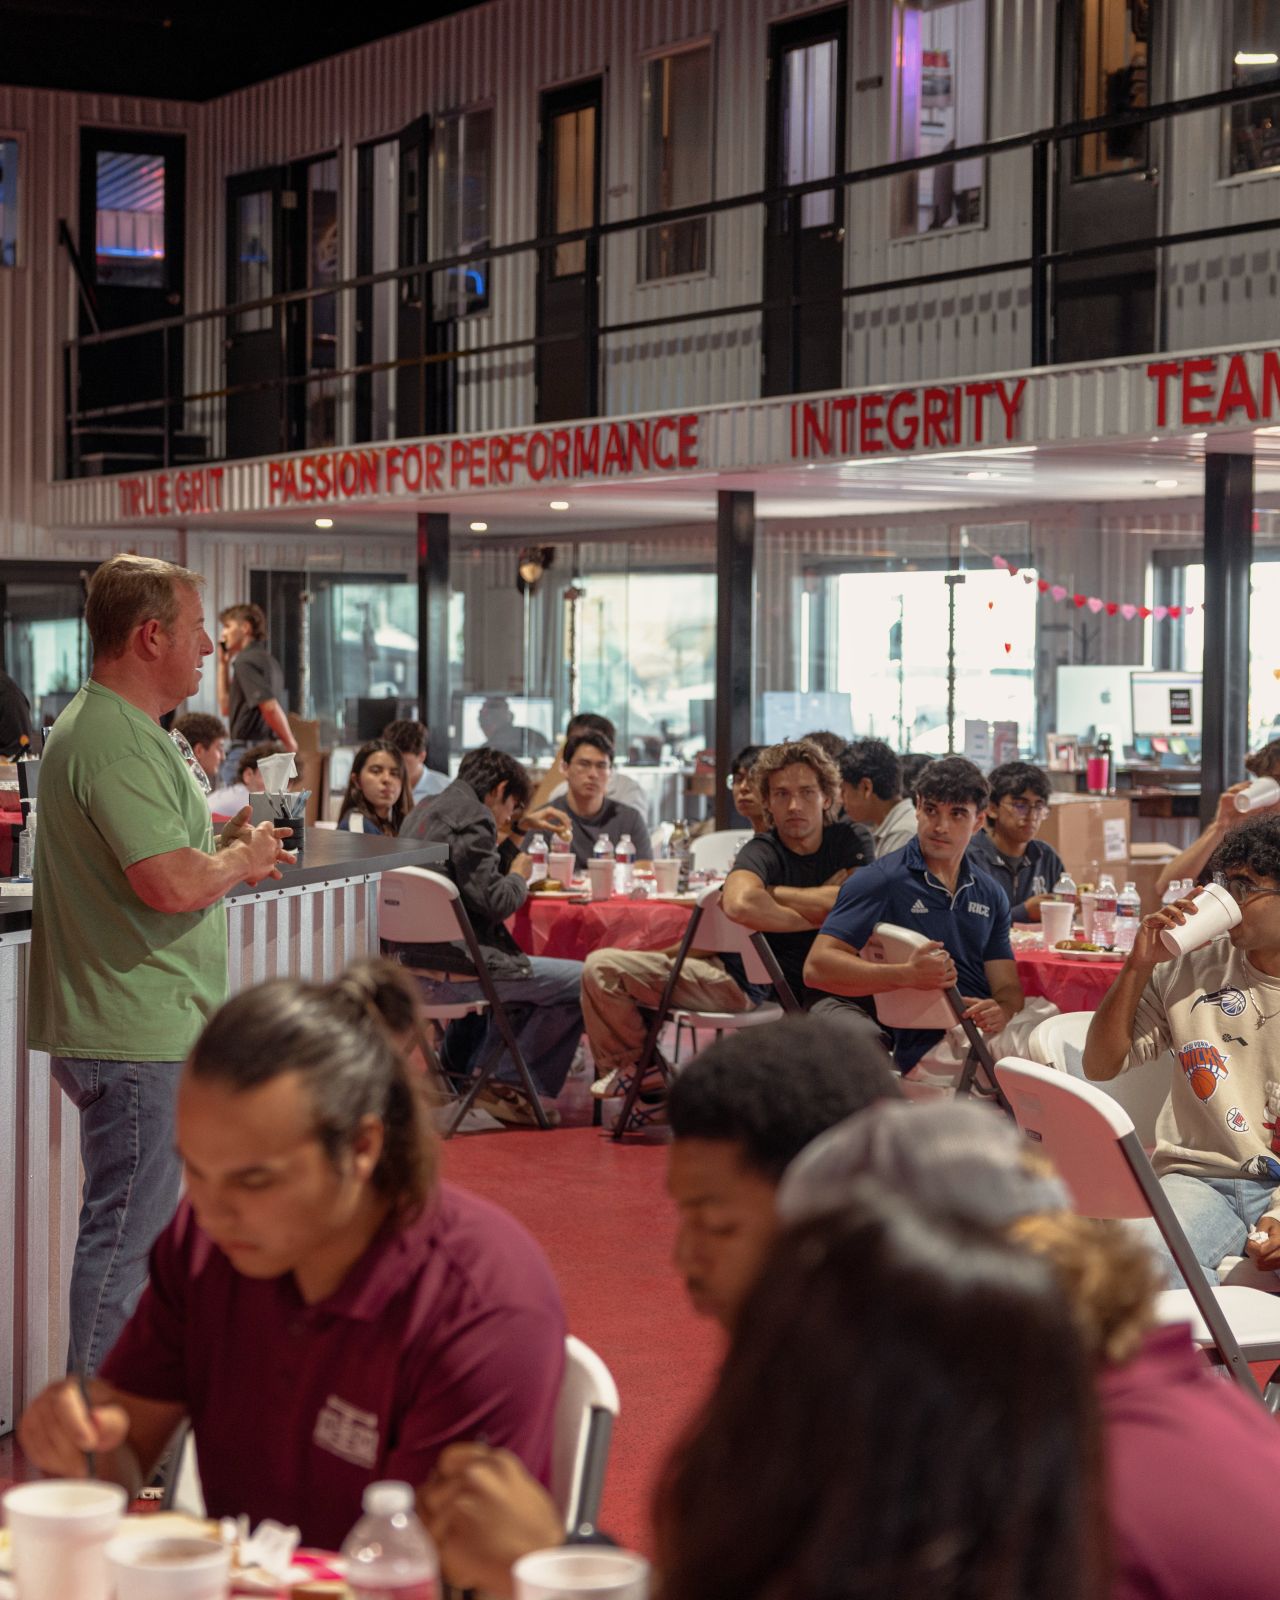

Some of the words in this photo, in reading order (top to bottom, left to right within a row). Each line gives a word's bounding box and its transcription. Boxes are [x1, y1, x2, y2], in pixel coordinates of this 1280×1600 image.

[791, 379, 1027, 458] INTEGRITY
[269, 449, 379, 504] PASSION
[386, 443, 443, 493] FOR
[450, 414, 699, 487] PERFORMANCE
[119, 475, 170, 516] TRUE
[175, 467, 224, 513] GRIT
[968, 901, 990, 917] RICE
[1179, 1045, 1228, 1074] NICKS
